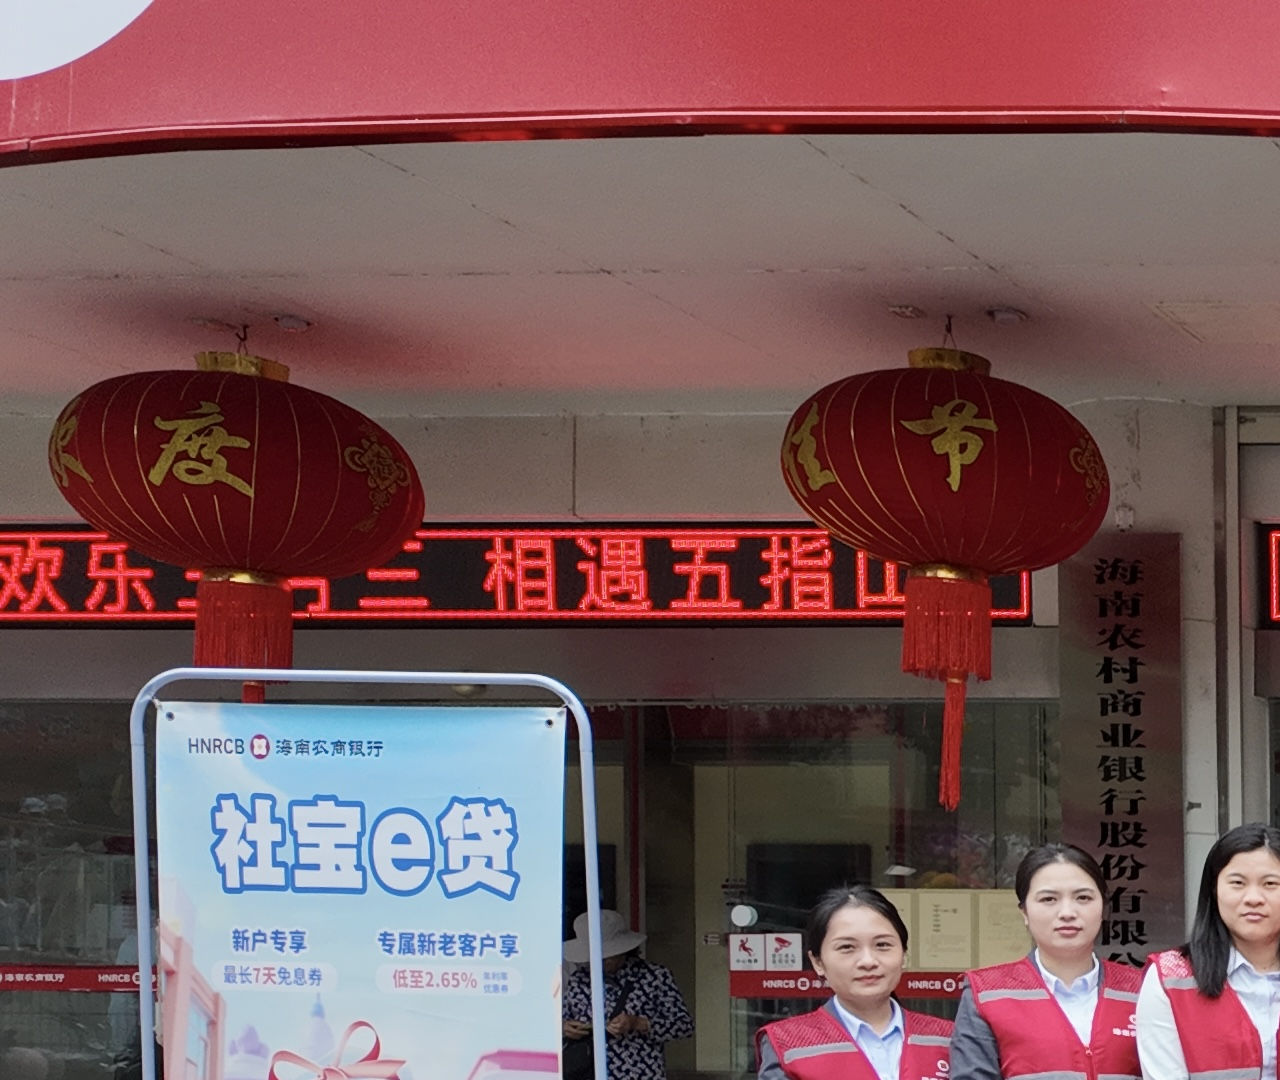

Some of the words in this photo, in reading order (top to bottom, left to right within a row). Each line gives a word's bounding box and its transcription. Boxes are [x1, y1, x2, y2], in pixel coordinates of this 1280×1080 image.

[148, 400, 255, 498] 度
[900, 399, 998, 493] 节
[0, 535, 430, 613] 欢乐三
[188, 738, 246, 757] HNRCB
[275, 739, 385, 758] 海南农商银行
[210, 793, 521, 901] 社宝e贷
[231, 928, 308, 954] 新户专享
[378, 931, 520, 958] 专属新老客户享
[97, 973, 131, 983] HNRCB
[223, 965, 323, 988] 最长7天免息券
[392, 967, 479, 990] 低至2.65%
[763, 979, 795, 989] HNRCB
[907, 980, 942, 991] HNRCB
